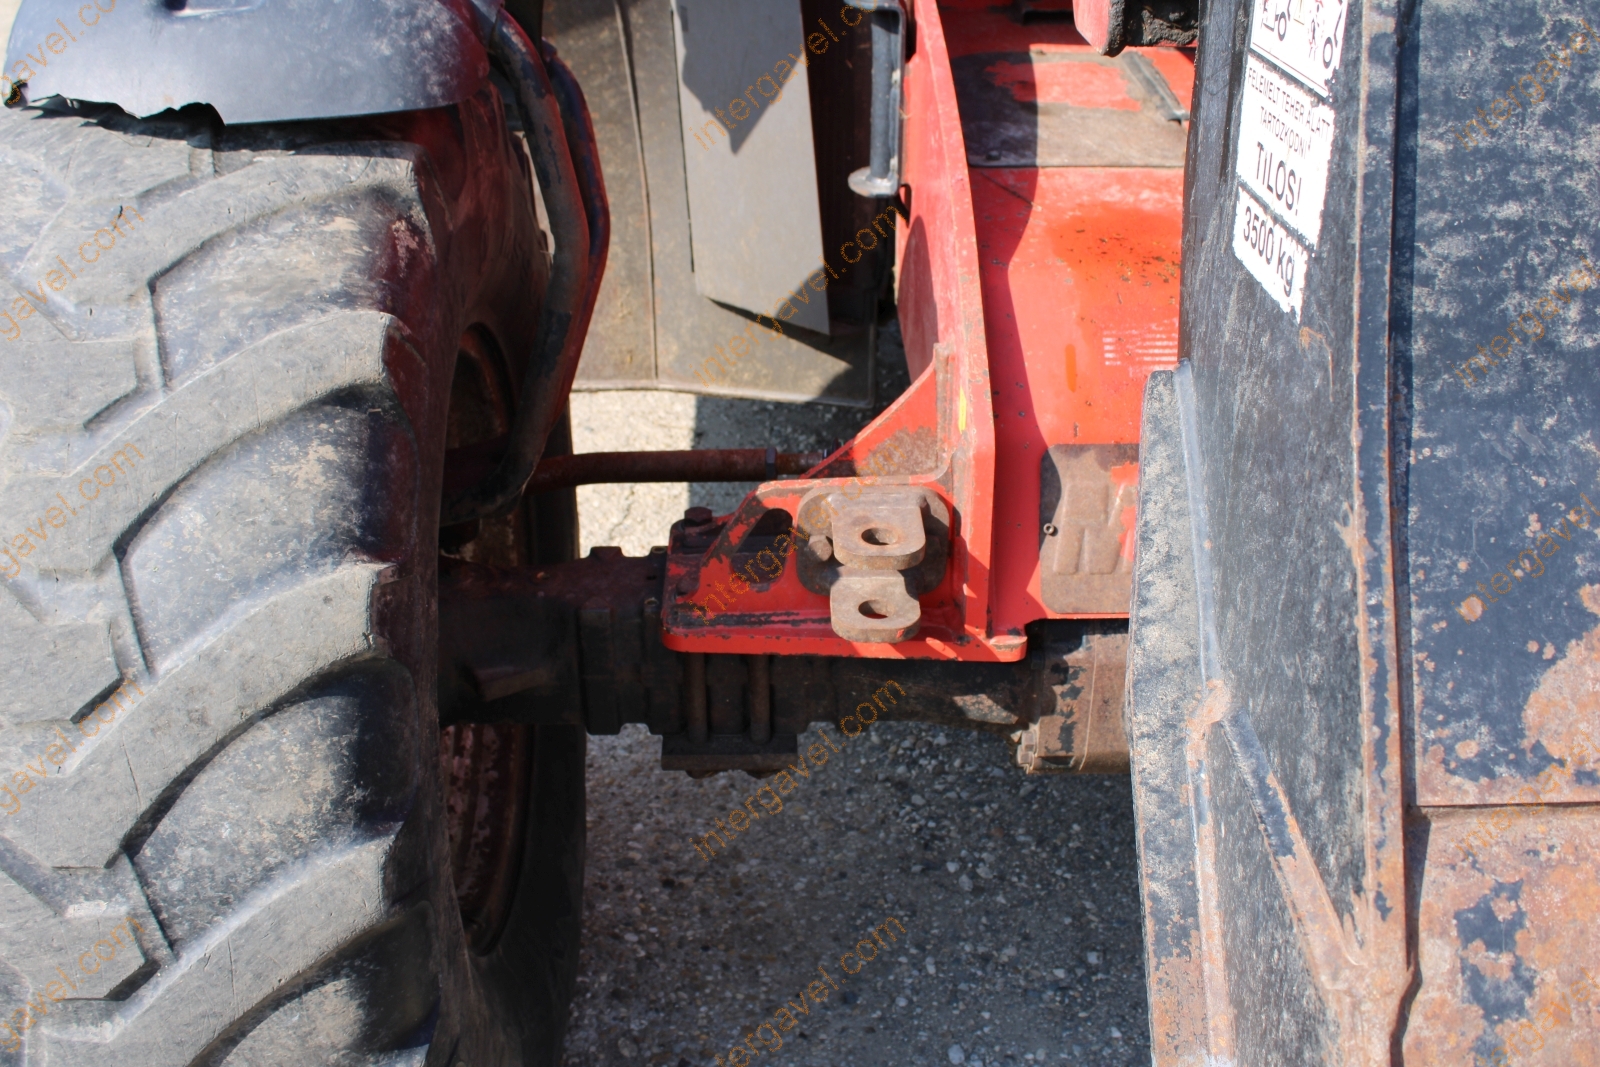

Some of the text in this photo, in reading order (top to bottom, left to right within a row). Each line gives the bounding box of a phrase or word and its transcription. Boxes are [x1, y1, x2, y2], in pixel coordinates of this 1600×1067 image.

[1247, 67, 1331, 142] FELEMELT TEHER ALATT
[1256, 140, 1302, 216] TILOS!
[1243, 205, 1295, 298] 3500 kg
